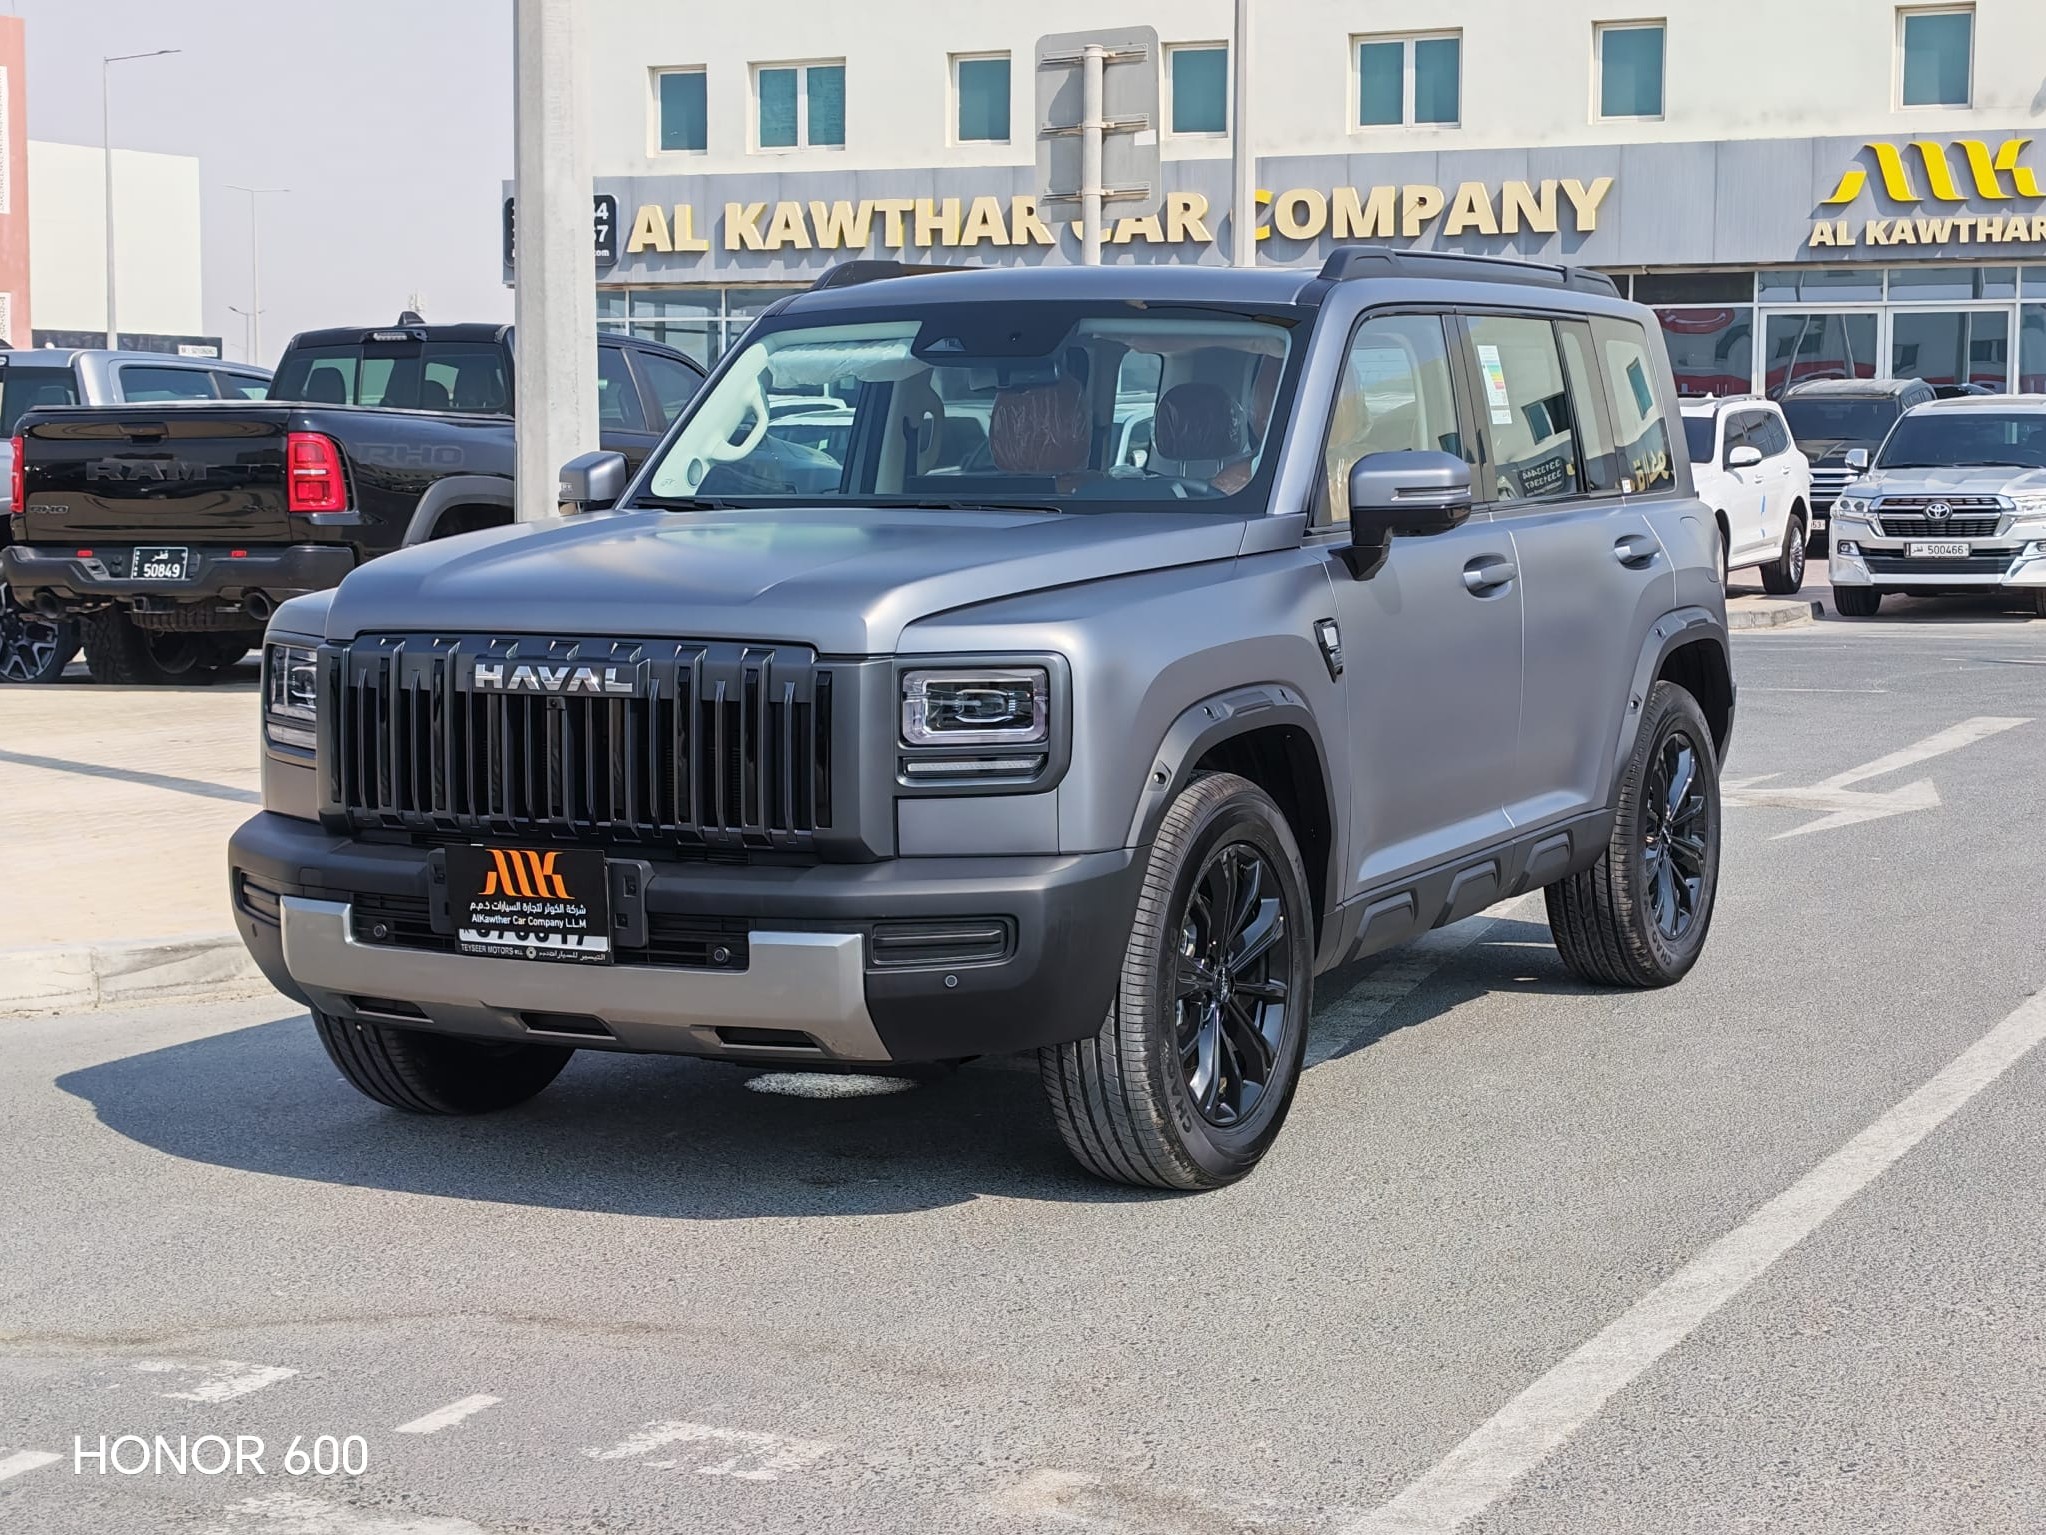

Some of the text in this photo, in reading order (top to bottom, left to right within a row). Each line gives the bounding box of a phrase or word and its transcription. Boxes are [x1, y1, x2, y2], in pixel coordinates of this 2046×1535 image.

[627, 203, 709, 253] AL
[724, 196, 1056, 251] KAWTHAR
[1072, 191, 1213, 243] AR
[1808, 215, 2046, 247] AL KAWTHAR
[86, 460, 208, 481] RAM
[1927, 545, 1964, 555] 500466
[143, 563, 180, 578] 50849
[475, 663, 633, 693] HAVAL
[491, 901, 521, 912] السيارات
[522, 902, 543, 914] لتجارة
[544, 903, 564, 915] الكوثر
[566, 904, 586, 916] شركة
[512, 915, 526, 925] Car
[527, 916, 564, 928] Company
[461, 943, 487, 953] TEYSEER
[487, 945, 514, 955] MOTORS
